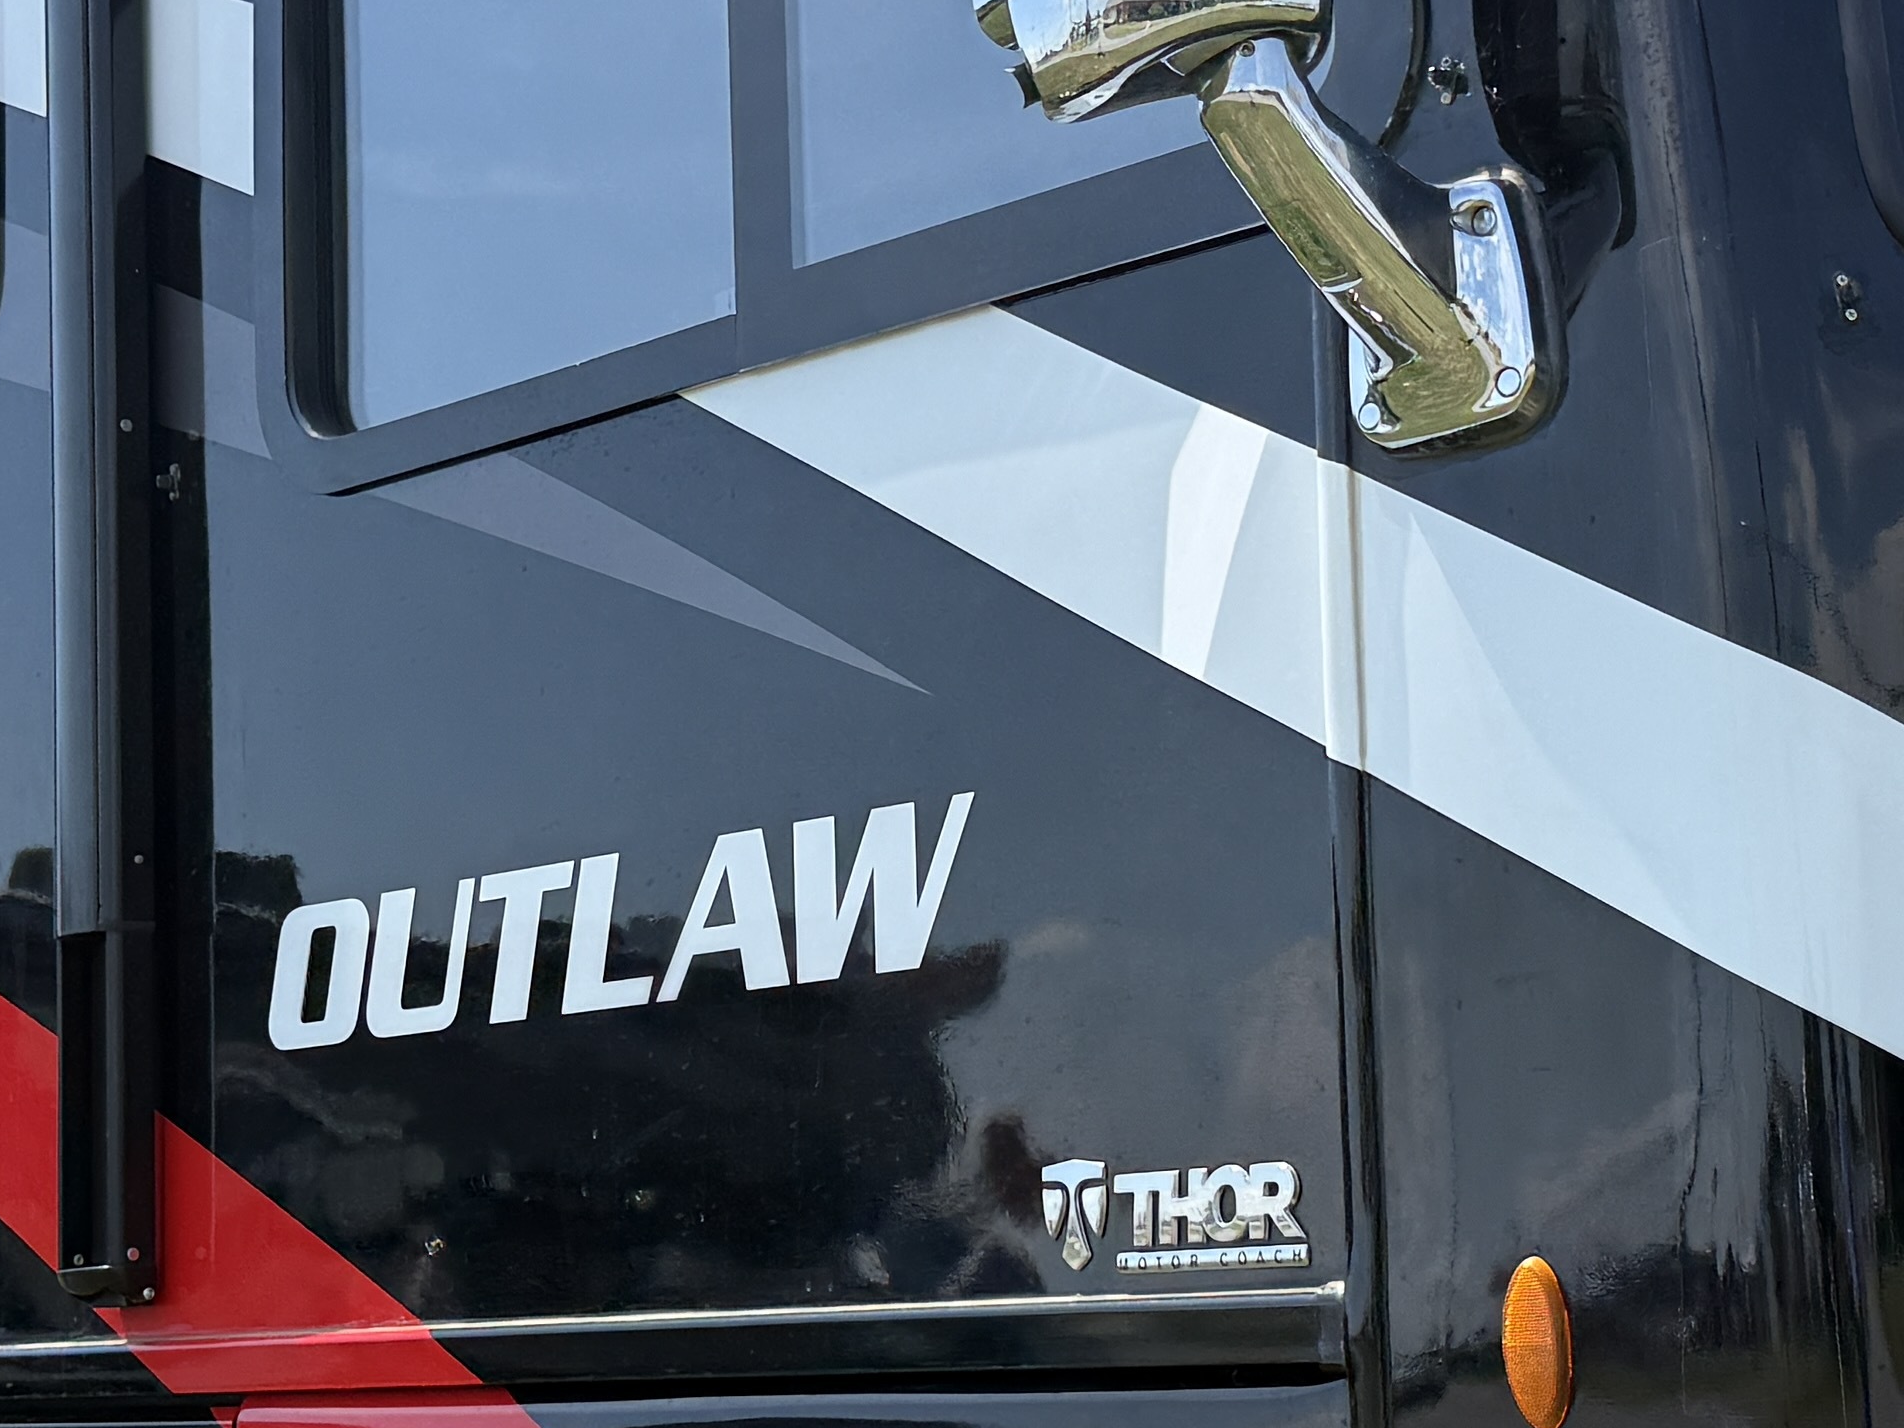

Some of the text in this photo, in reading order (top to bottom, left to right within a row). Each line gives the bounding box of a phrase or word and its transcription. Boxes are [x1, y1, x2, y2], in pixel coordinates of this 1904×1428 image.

[268, 791, 975, 1051] OUTLAW
[1113, 1161, 1307, 1247] THOR
[1118, 1248, 1304, 1270] MOTOR COACH
